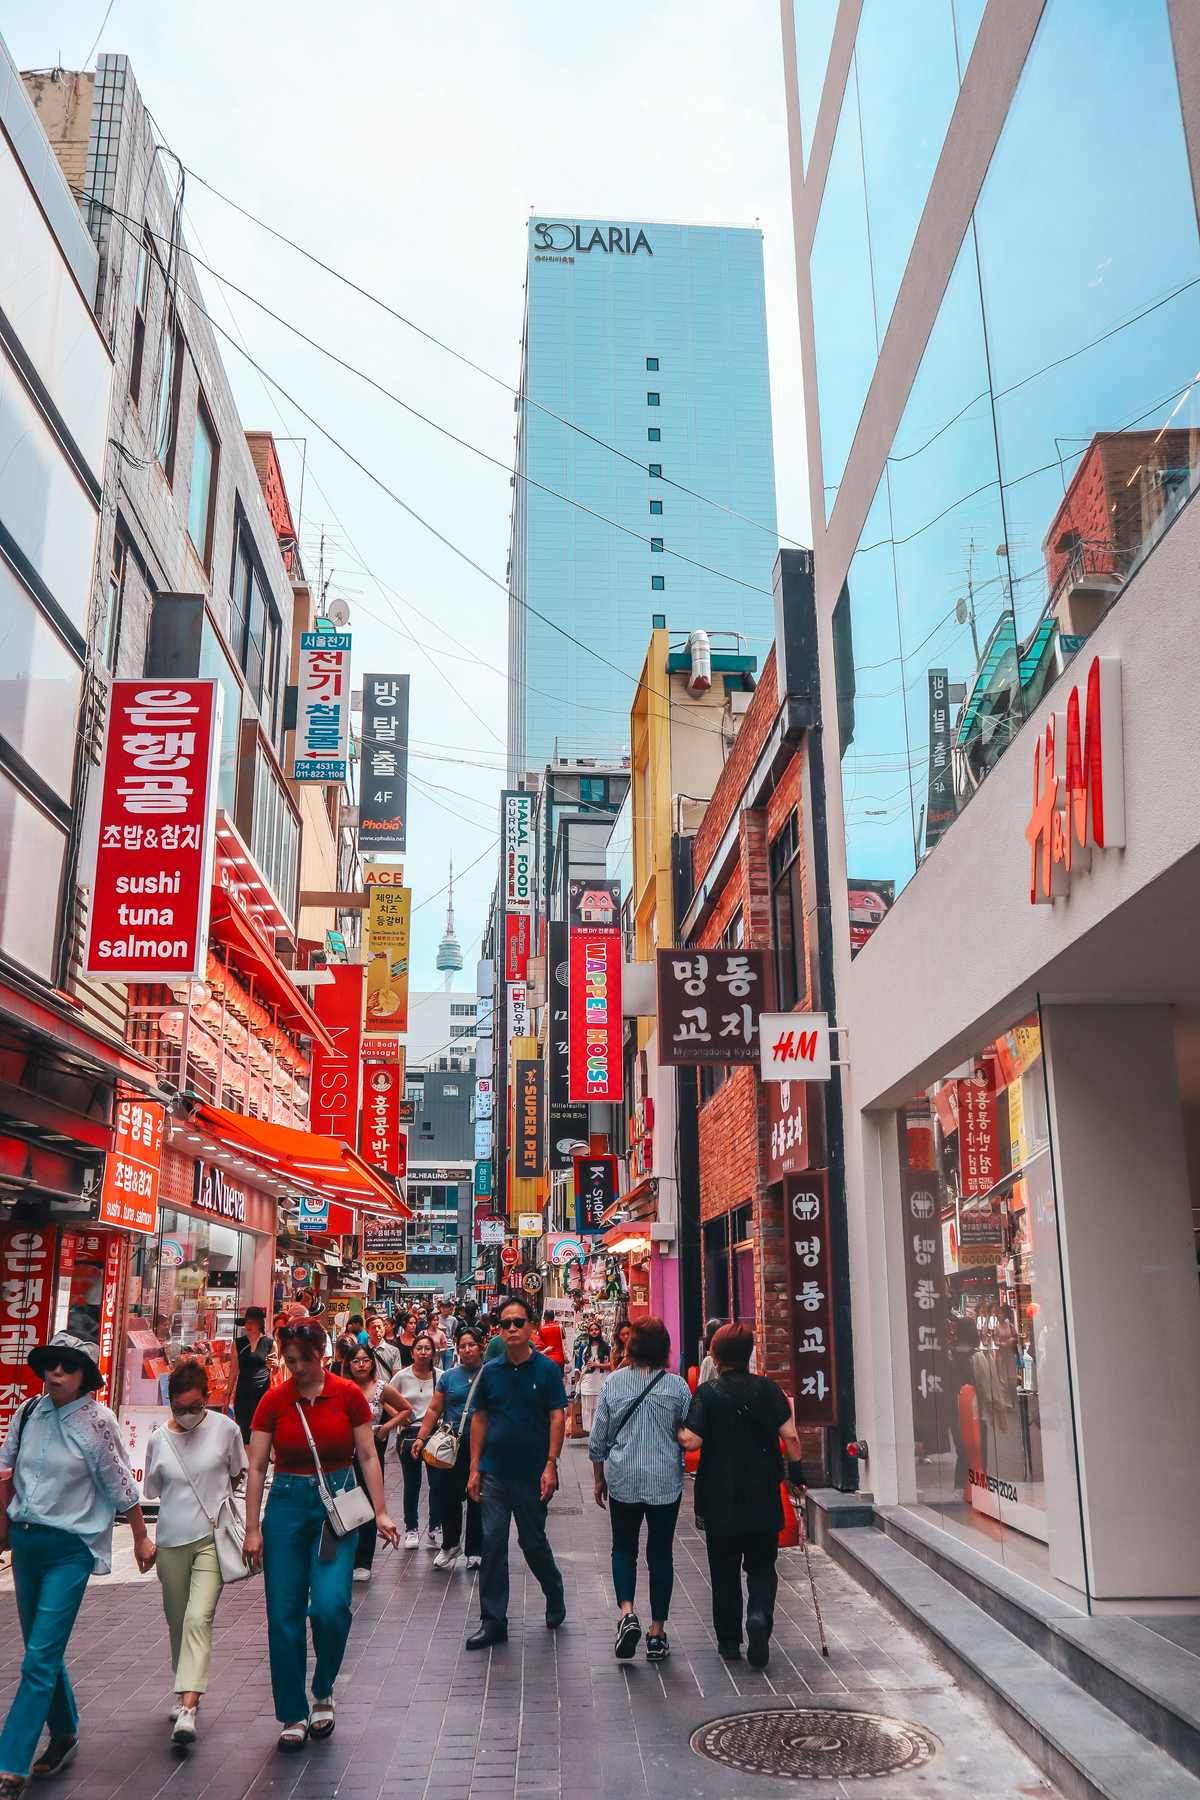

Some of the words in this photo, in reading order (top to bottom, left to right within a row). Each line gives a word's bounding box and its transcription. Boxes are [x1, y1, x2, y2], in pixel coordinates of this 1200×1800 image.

[534, 222, 653, 256] SOLARIA
[303, 636, 349, 648] 서울전기
[371, 681, 400, 776] 방탈출
[116, 688, 199, 815] 은행골
[373, 791, 393, 803] 4F
[1024, 655, 1104, 905] H&M
[101, 823, 201, 851] 초밥&참치
[507, 799, 516, 852] GURKHA
[517, 799, 528, 847] HALAL
[115, 870, 181, 895] sushi
[366, 871, 402, 884] ACE
[517, 854, 528, 897] FOOD
[117, 905, 174, 927] tuna
[375, 893, 403, 904] 제임스
[380, 904, 398, 914] 치즈
[376, 915, 404, 926] 등갈비
[97, 935, 189, 959] salmon
[586, 943, 608, 1024] WAPPEN
[672, 954, 758, 997] 명동
[673, 1003, 759, 1045] 교자
[376, 1041, 397, 1049] Body
[586, 1029, 608, 1093] HOUSE
[772, 1030, 818, 1062] H&M
[118, 1102, 153, 1147] 은행골
[523, 1085, 537, 1136] SUPER
[772, 1105, 803, 1160] 명동교자
[523, 1140, 537, 1168] PET
[114, 1161, 153, 1199] 초밥&참치
[197, 1159, 212, 1208] La
[213, 1167, 246, 1222] Nueva
[136, 1208, 152, 1225] salmon
[0, 1233, 47, 1365] 은행골
[794, 1235, 829, 1401] 명동교자
[968, 1467, 998, 1495] SUMMER
[998, 1479, 1018, 1503] 2024
